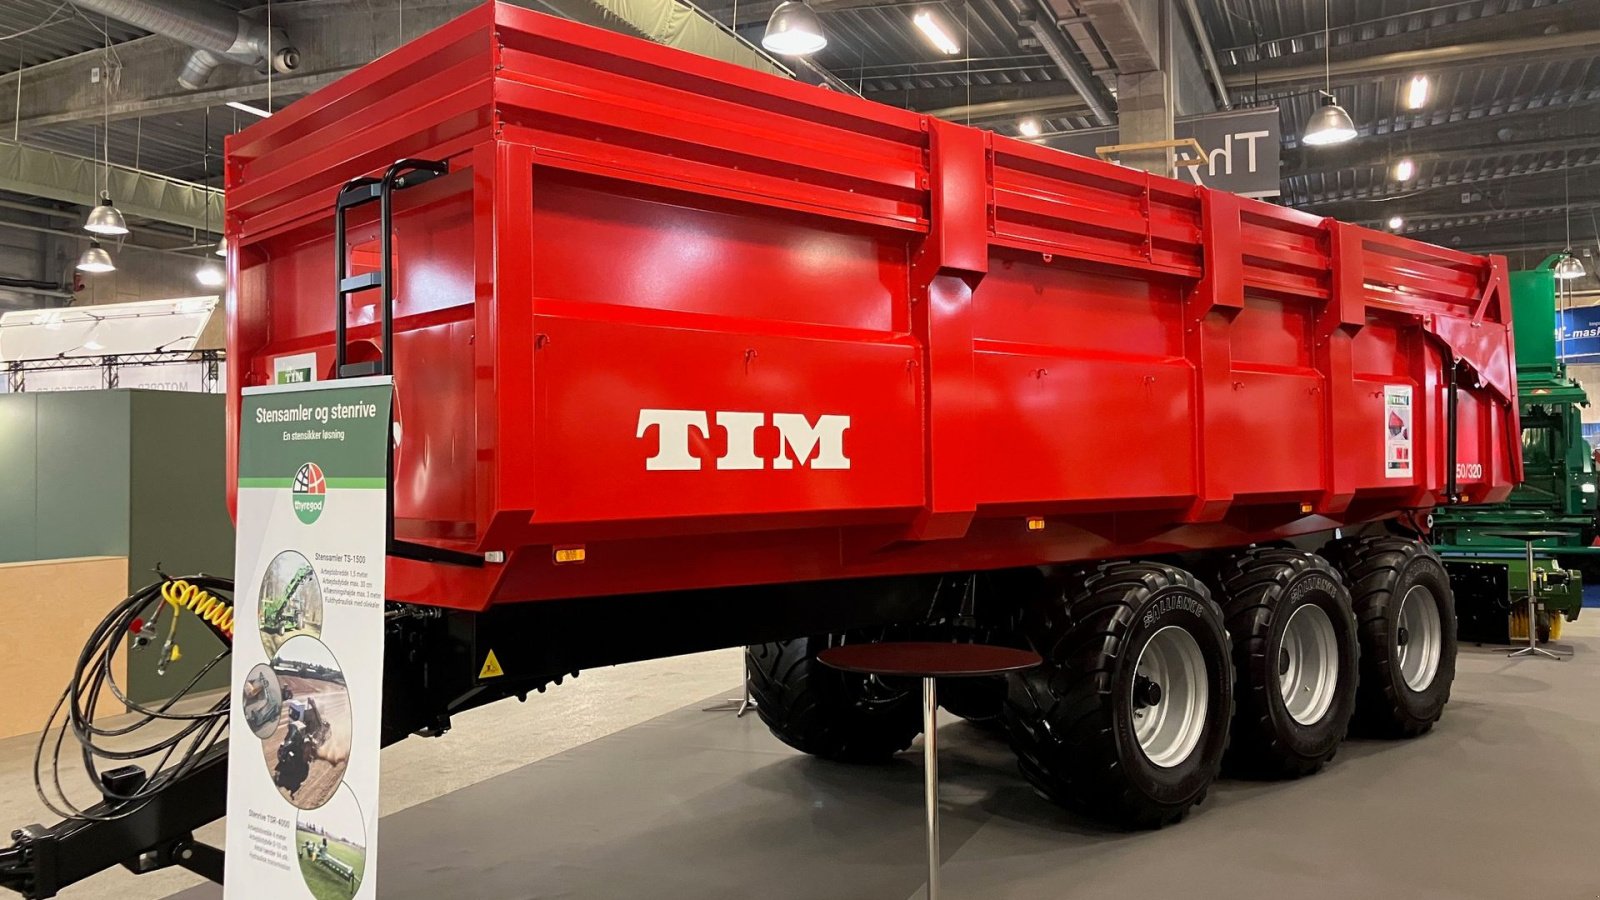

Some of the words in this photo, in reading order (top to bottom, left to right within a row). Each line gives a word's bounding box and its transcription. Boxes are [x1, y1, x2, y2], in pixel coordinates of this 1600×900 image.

[256, 404, 313, 424] Stensamler
[315, 407, 329, 424] og
[331, 400, 377, 419] stenrive
[283, 431, 291, 441] En
[291, 429, 322, 441] stensikker
[322, 429, 345, 442] løsning
[636, 408, 851, 471] TIM
[294, 500, 322, 512] thyregod
[315, 552, 343, 562] Stensamler
[343, 554, 366, 564] TS-1500
[1152, 596, 1204, 621] ALLIANCE
